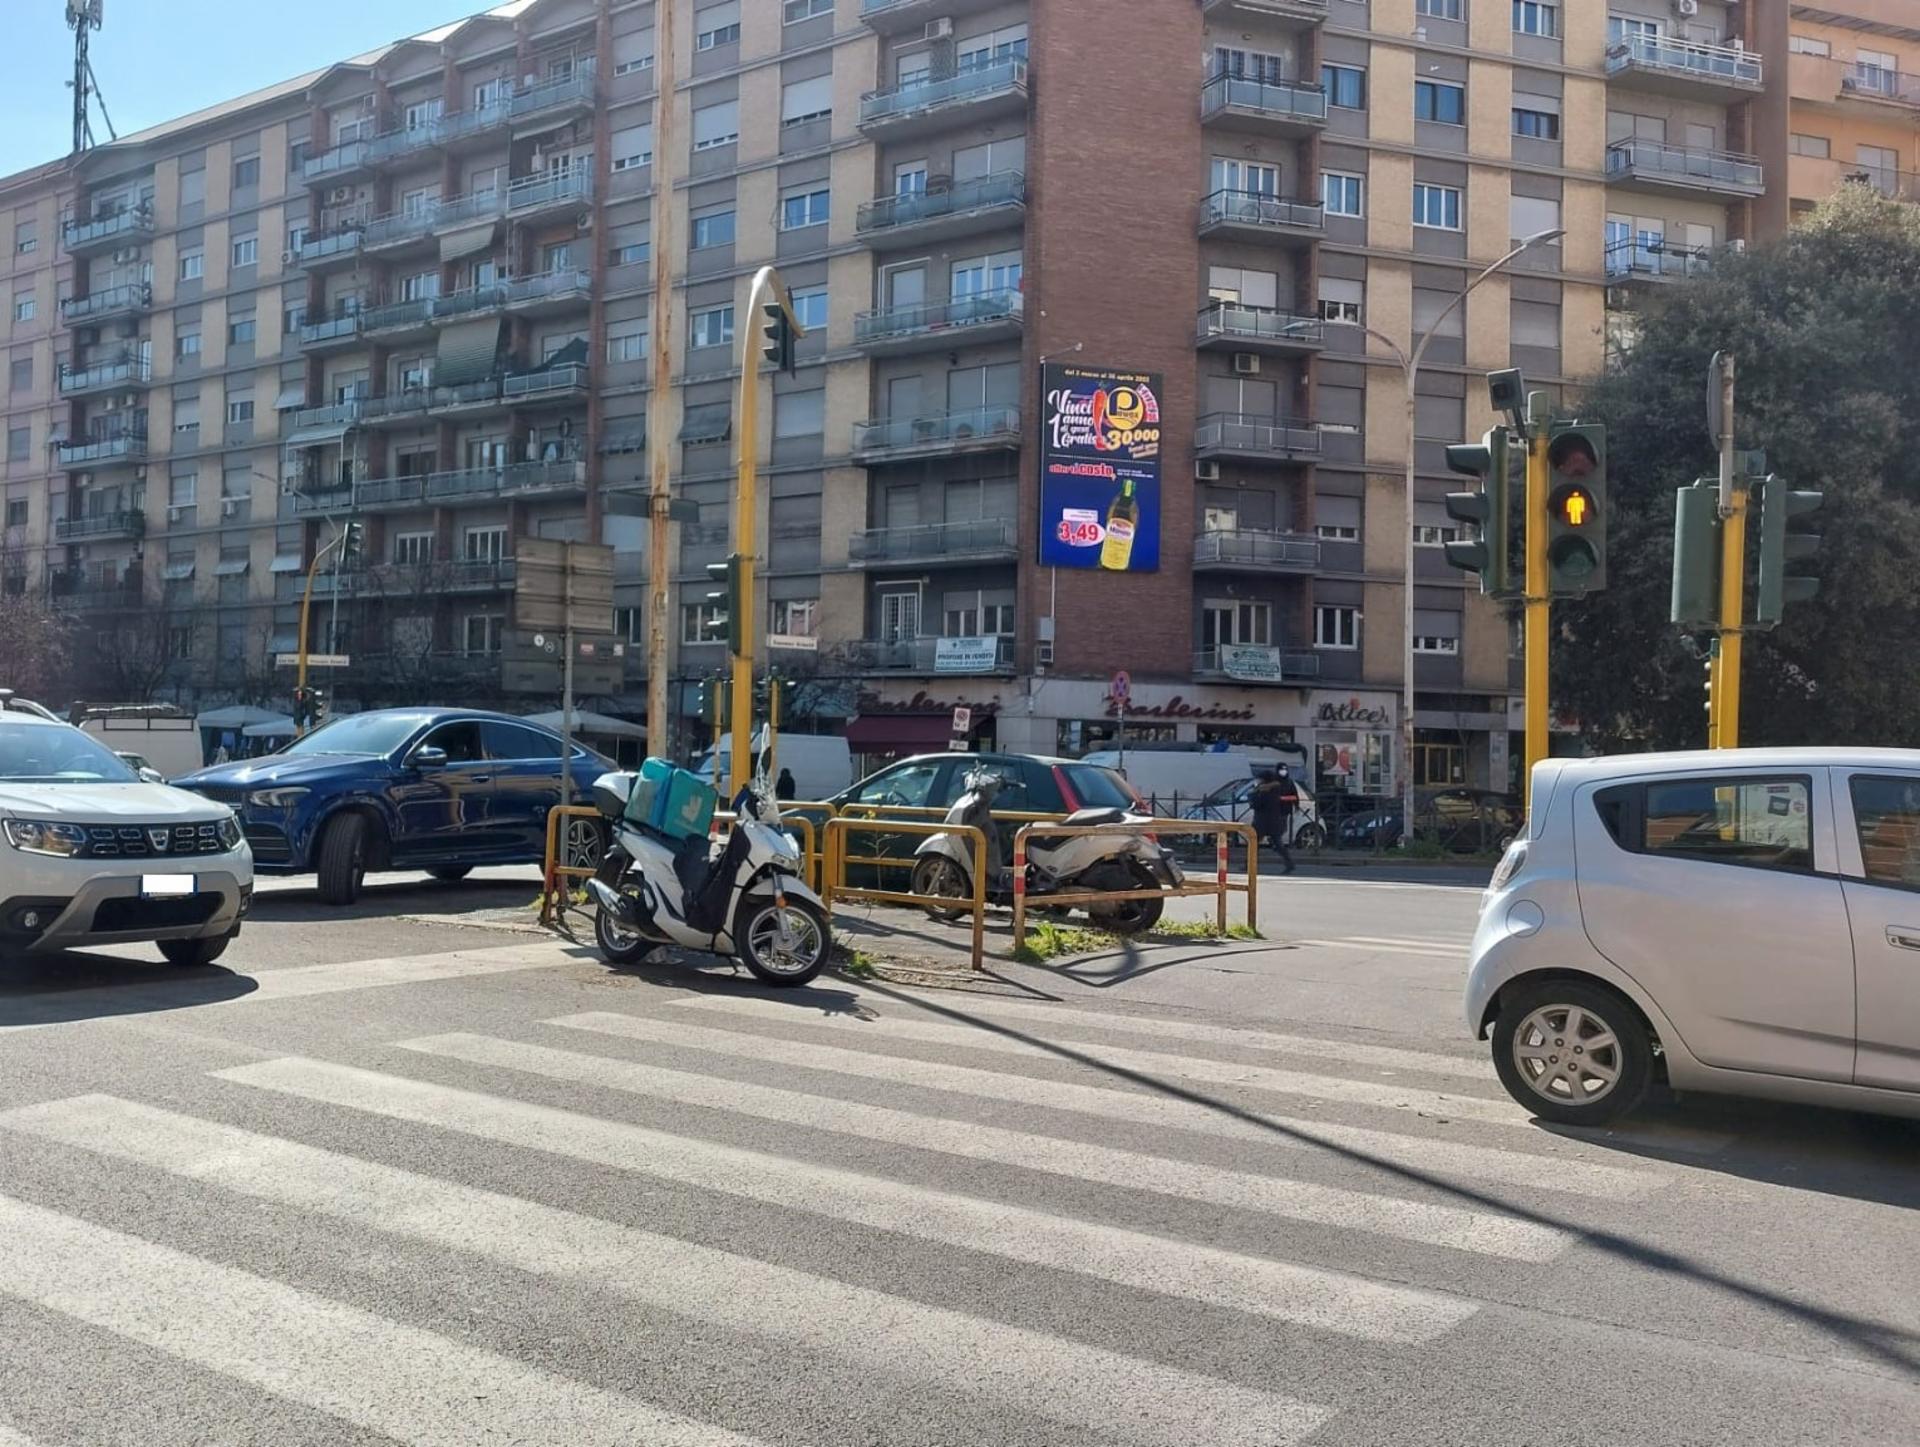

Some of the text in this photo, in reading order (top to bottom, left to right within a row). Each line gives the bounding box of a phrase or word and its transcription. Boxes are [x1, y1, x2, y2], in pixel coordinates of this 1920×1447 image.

[1048, 389, 1093, 415] Vinci
[1048, 413, 1094, 448] 1 anno
[1060, 522, 1099, 544] 3,49
[1102, 696, 1256, 719] Barberini
